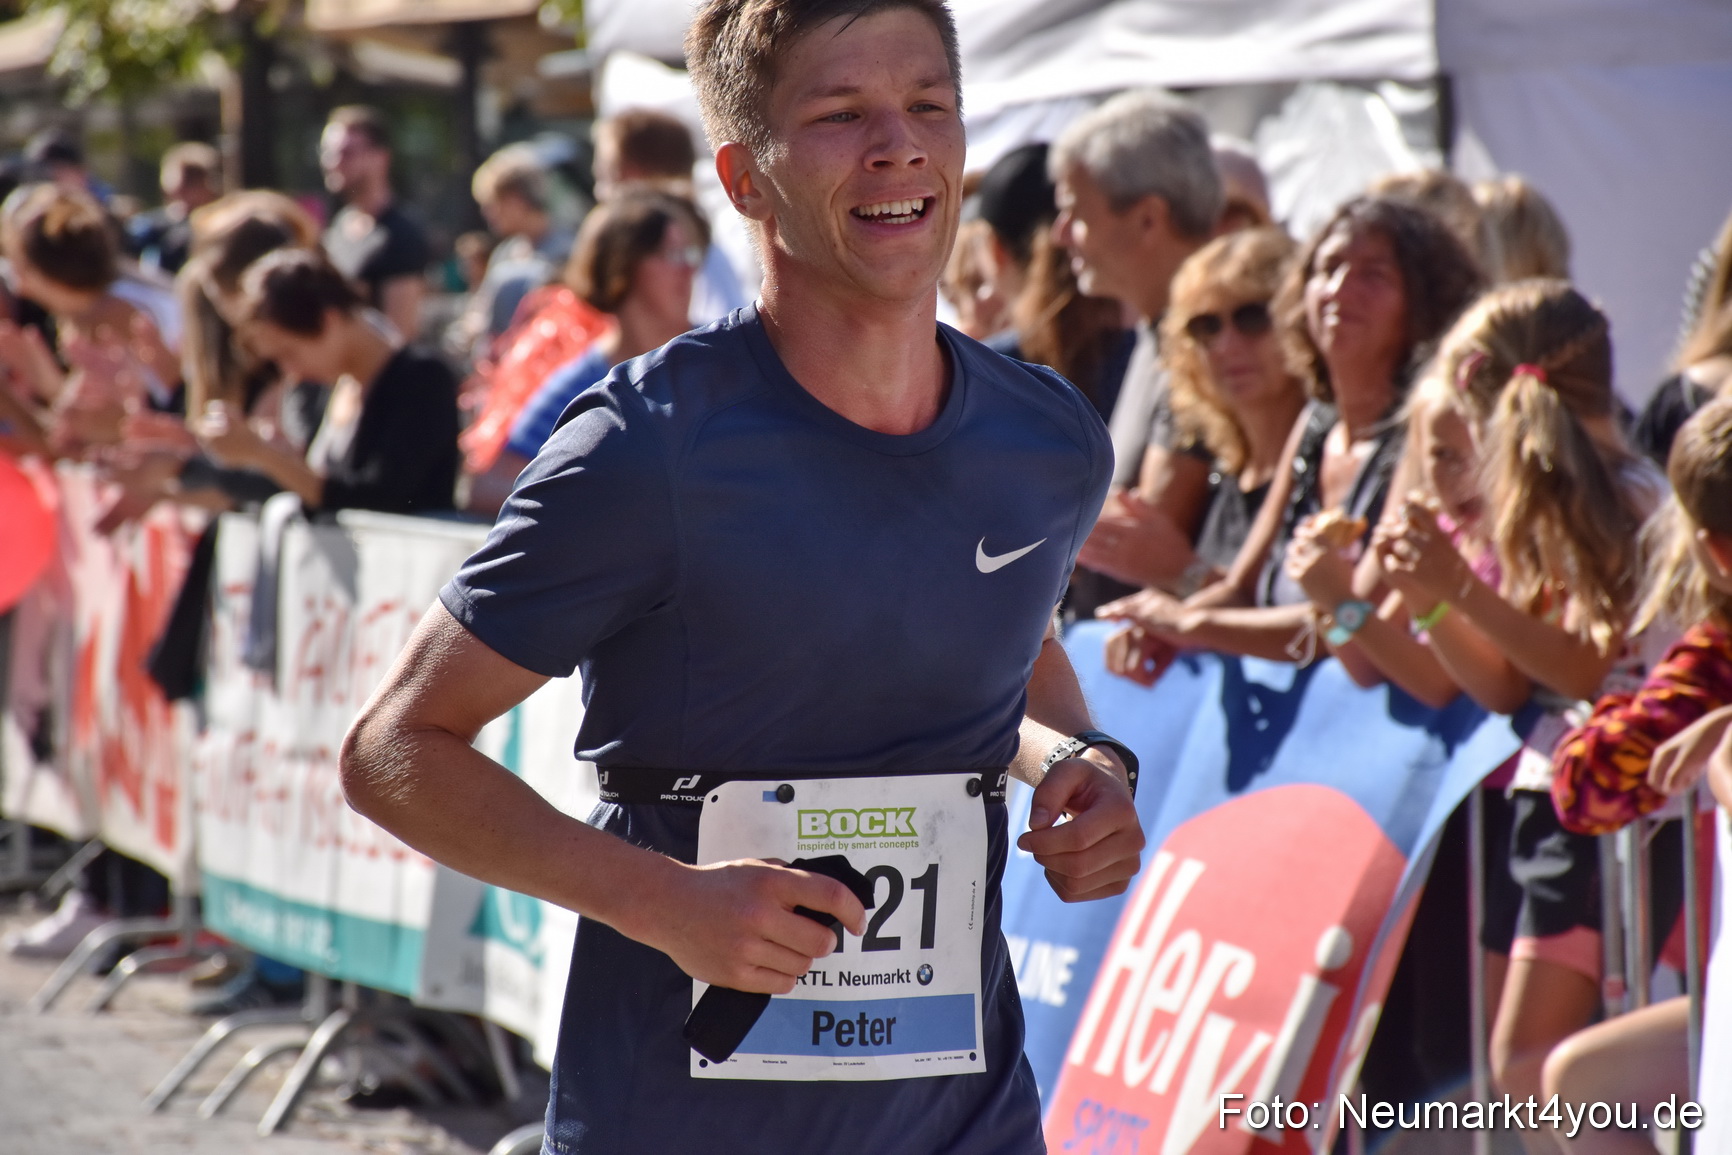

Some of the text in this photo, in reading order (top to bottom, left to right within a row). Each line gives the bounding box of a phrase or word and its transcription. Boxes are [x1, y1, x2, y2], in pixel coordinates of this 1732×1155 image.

[680, 794, 706, 802] TOUC
[798, 807, 918, 839] BOCK
[797, 840, 919, 852] inspired by smart concepts
[839, 969, 911, 987] Neumarkt
[811, 1010, 896, 1047] Peter
